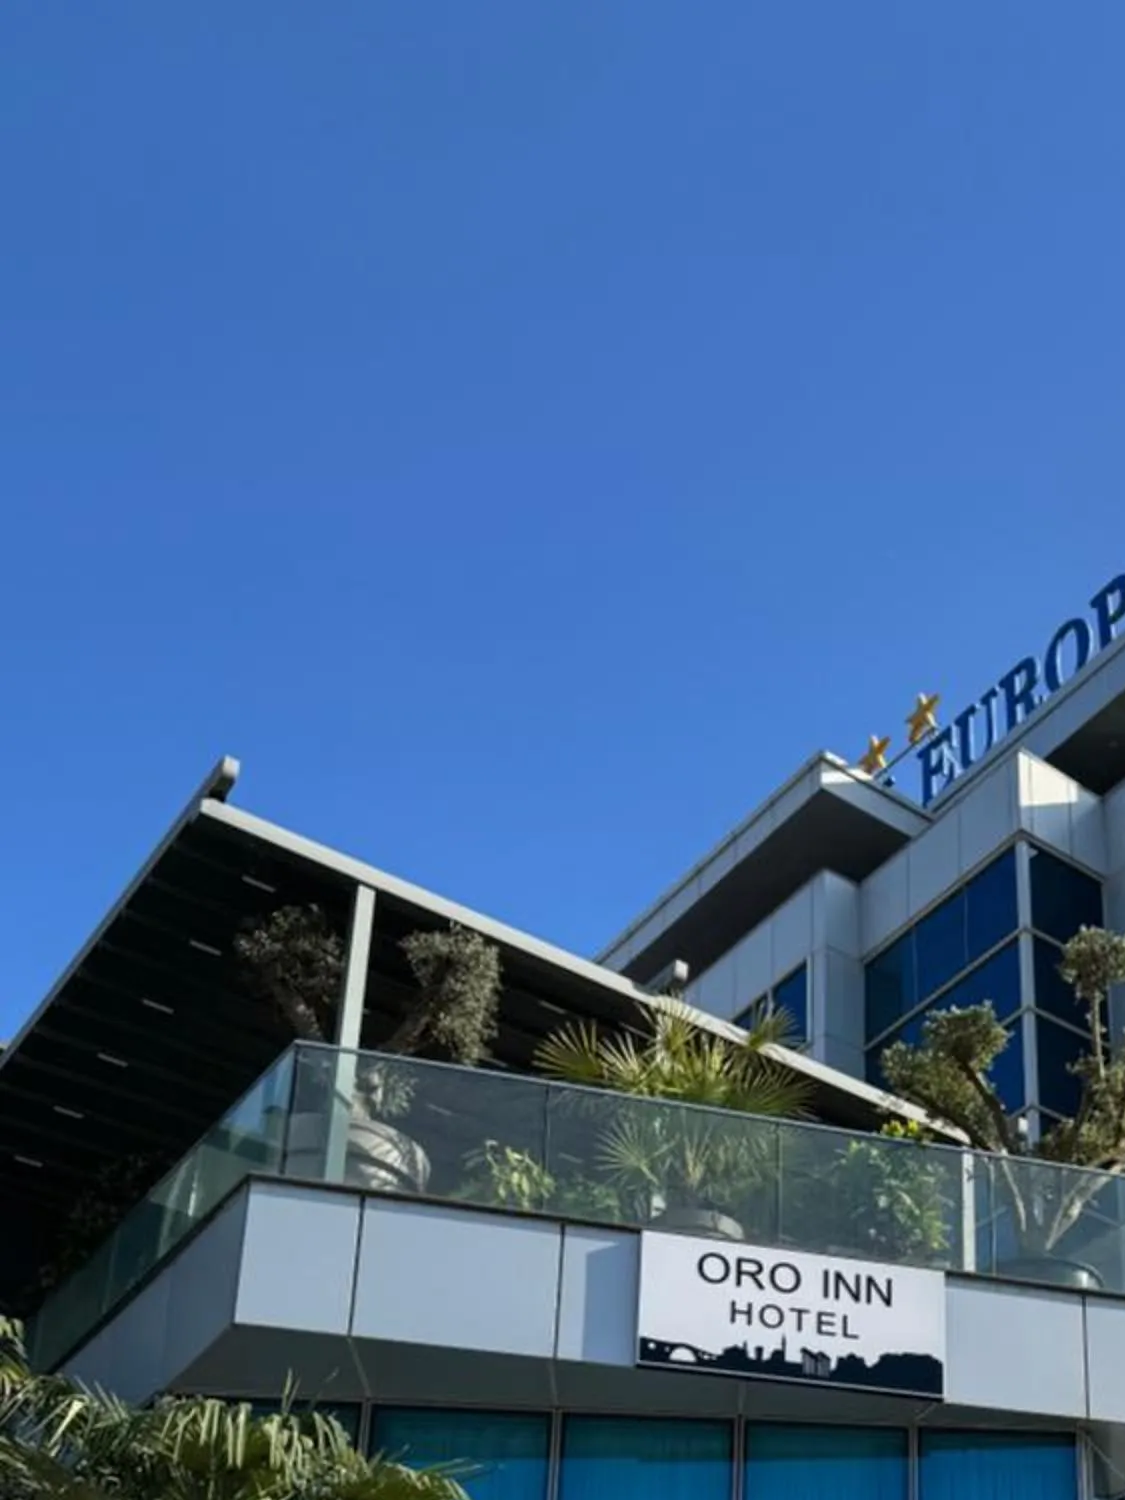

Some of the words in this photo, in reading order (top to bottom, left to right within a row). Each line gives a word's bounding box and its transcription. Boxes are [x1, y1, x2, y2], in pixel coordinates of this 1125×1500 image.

[697, 1252, 802, 1294] ORO
[822, 1268, 893, 1307] INN
[730, 1300, 860, 1340] HOTEL
